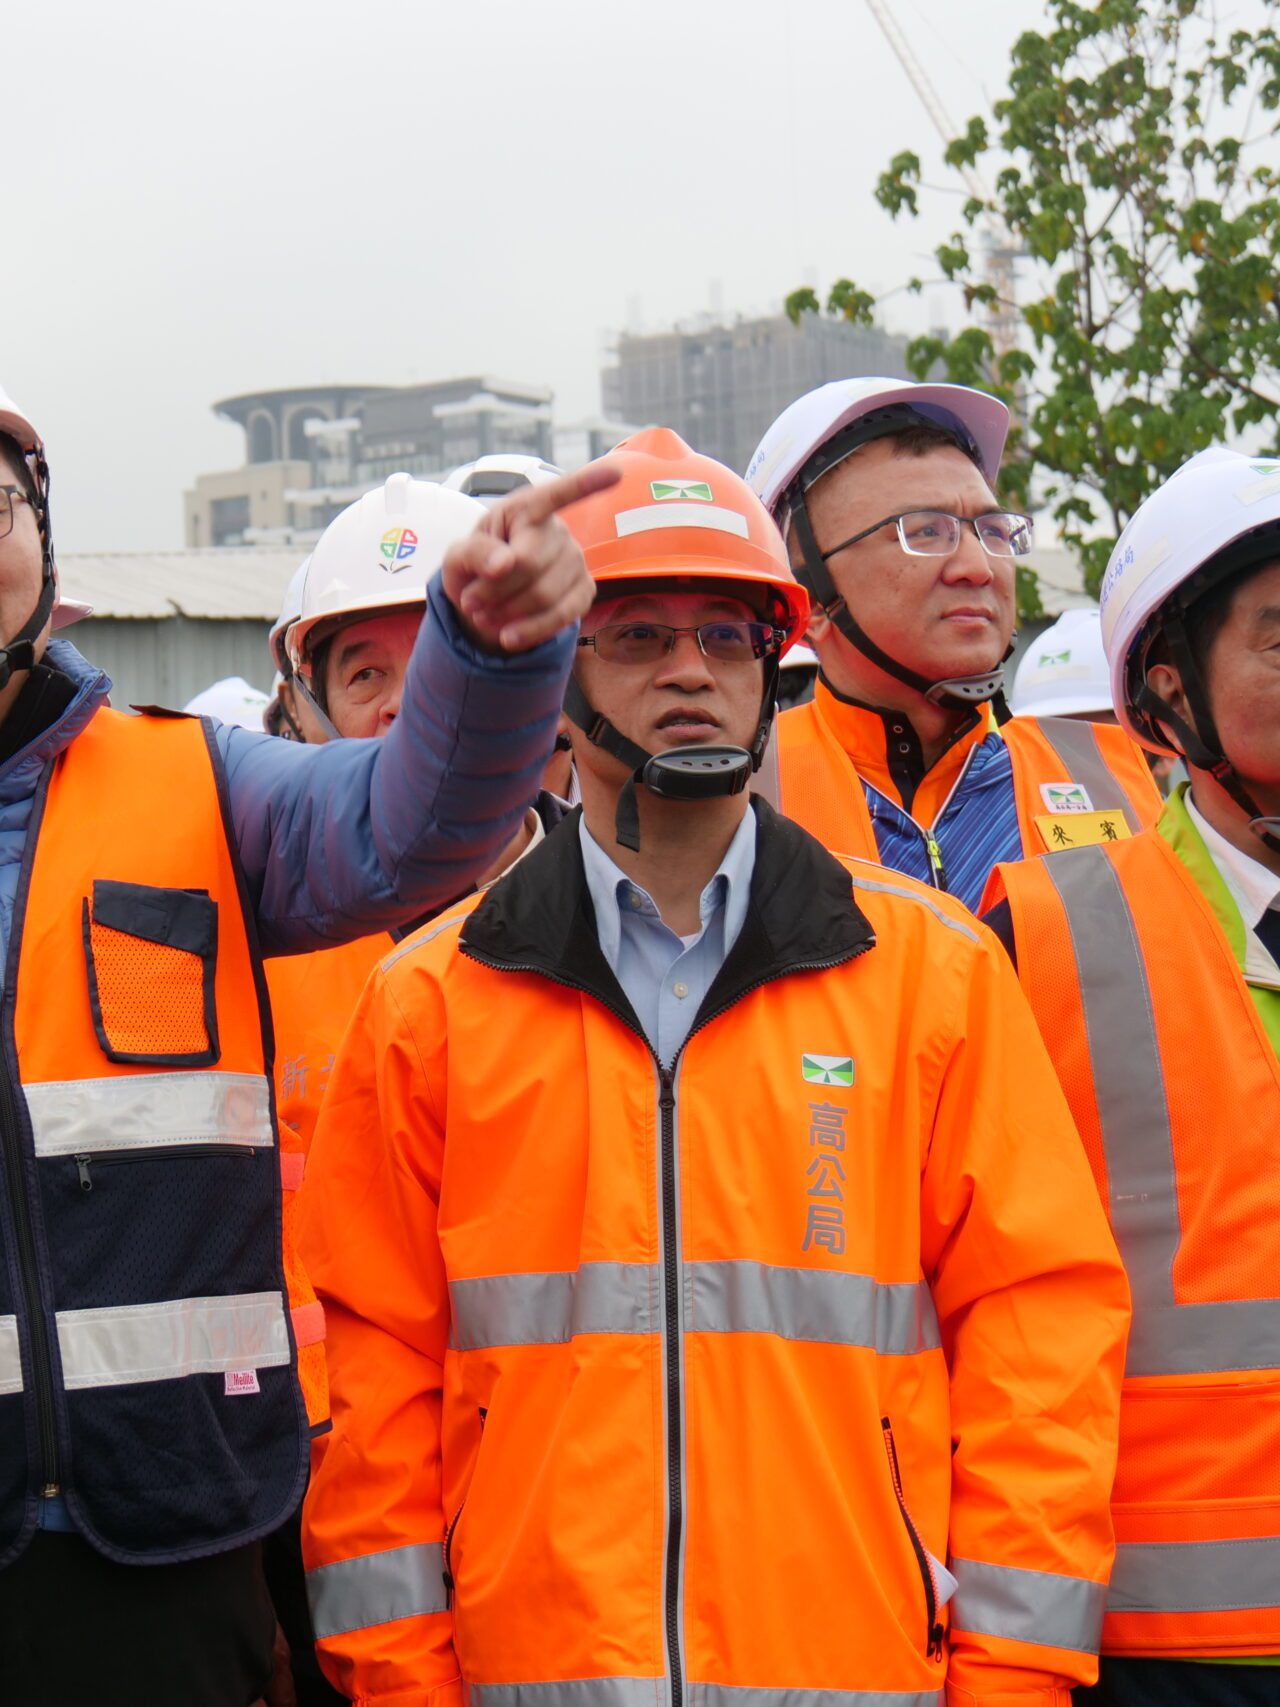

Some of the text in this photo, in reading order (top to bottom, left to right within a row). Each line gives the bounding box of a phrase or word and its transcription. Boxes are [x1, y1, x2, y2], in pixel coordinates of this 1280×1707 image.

[1053, 820, 1118, 846] 來賓
[802, 1102, 849, 1255] 高公局
